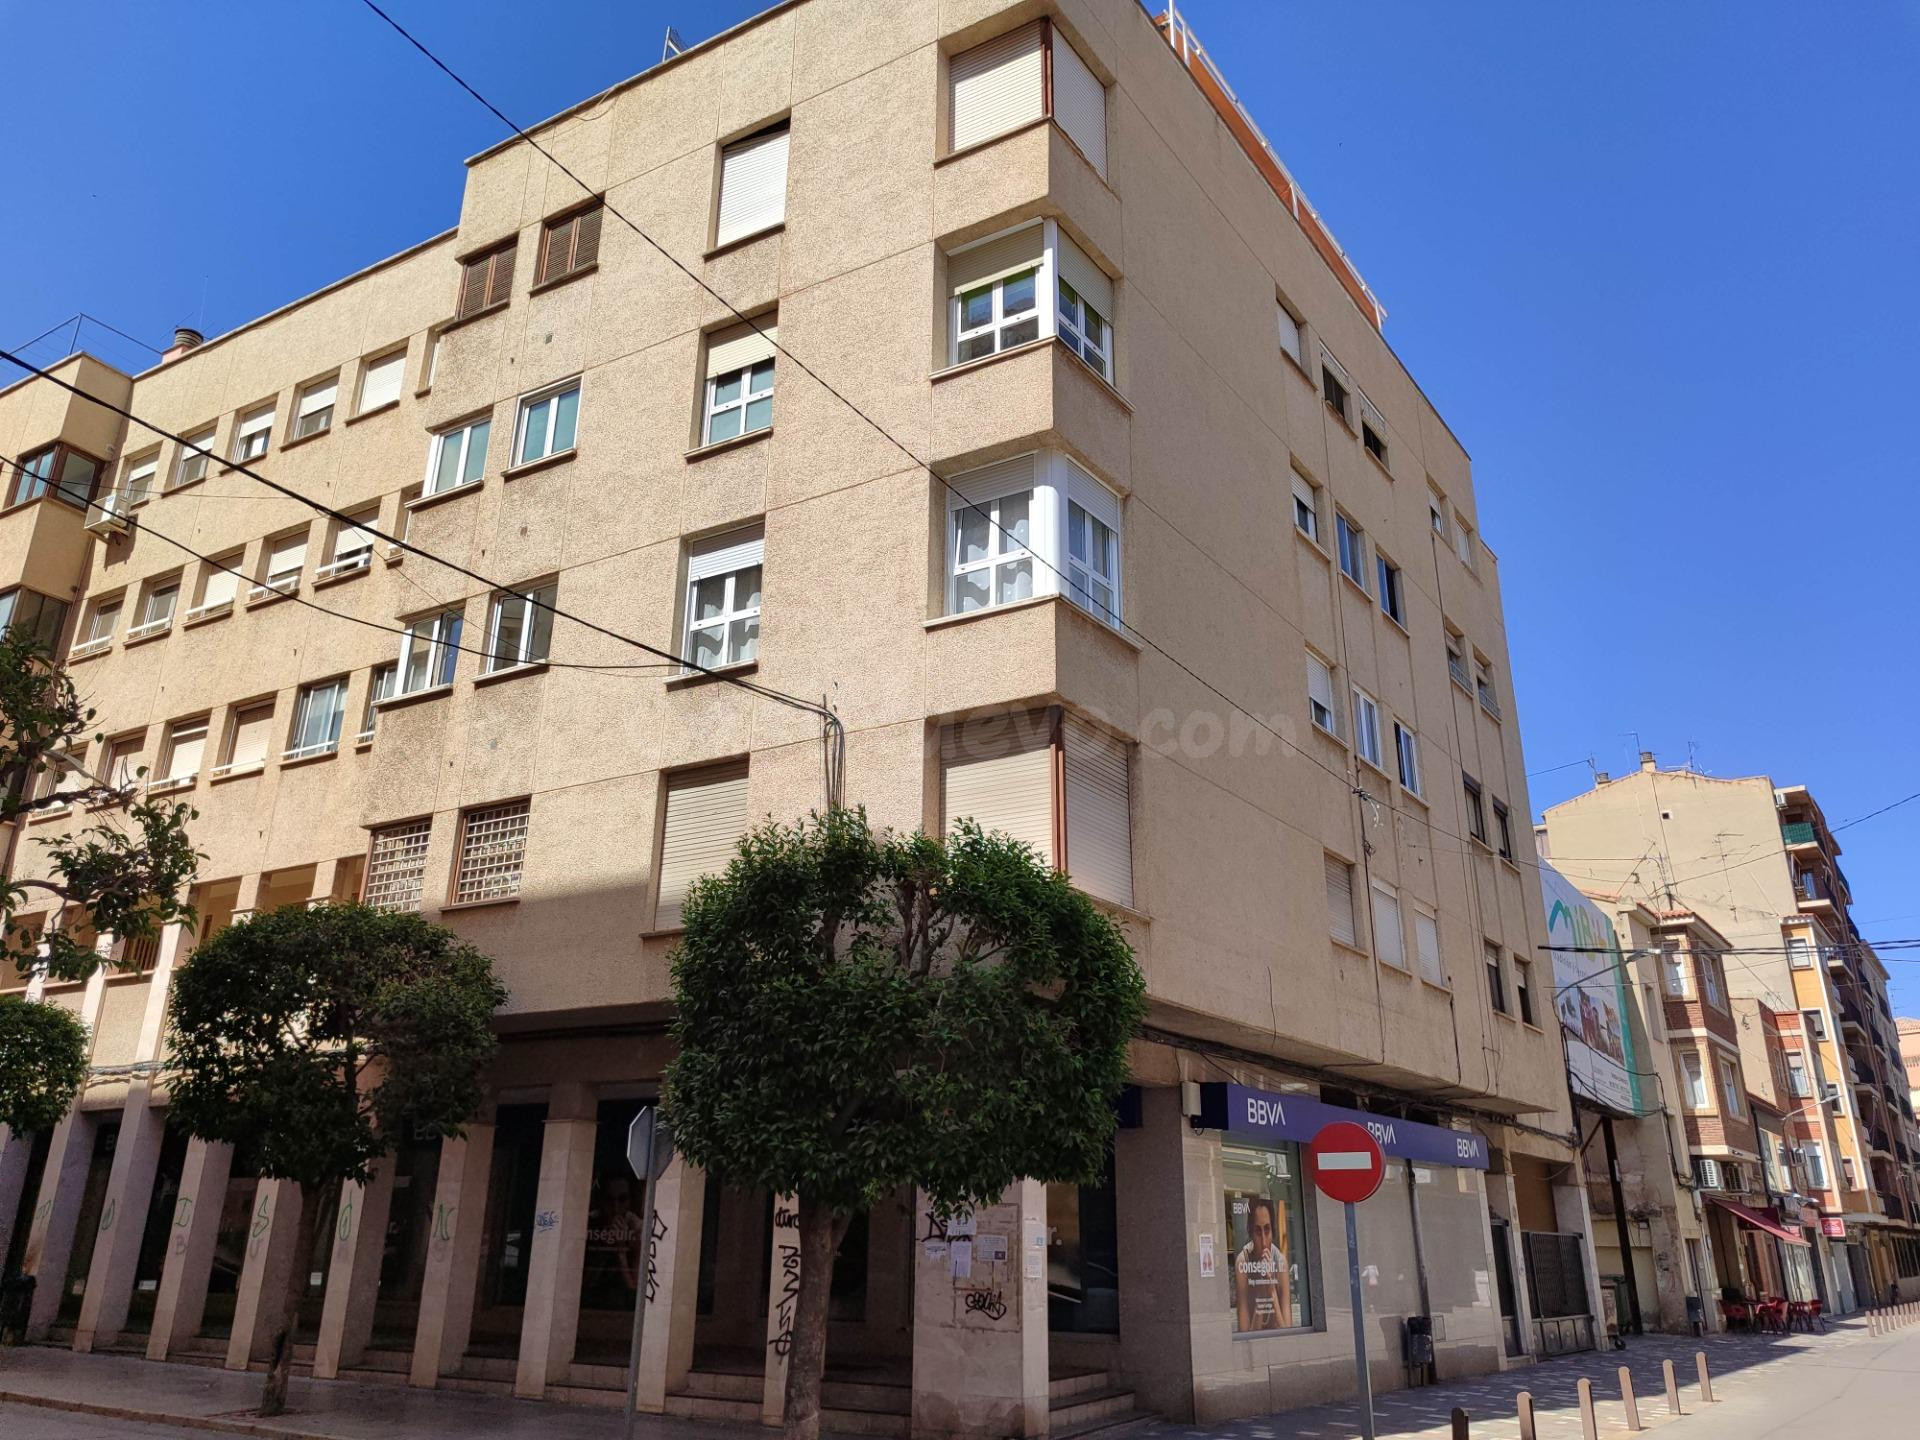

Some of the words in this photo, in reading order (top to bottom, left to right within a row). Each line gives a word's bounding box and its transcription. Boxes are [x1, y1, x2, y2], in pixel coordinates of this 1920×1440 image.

[1247, 1097, 1286, 1126] BBVA
[1456, 1138, 1480, 1158] BBVA
[1232, 1202, 1251, 1215] BBVA
